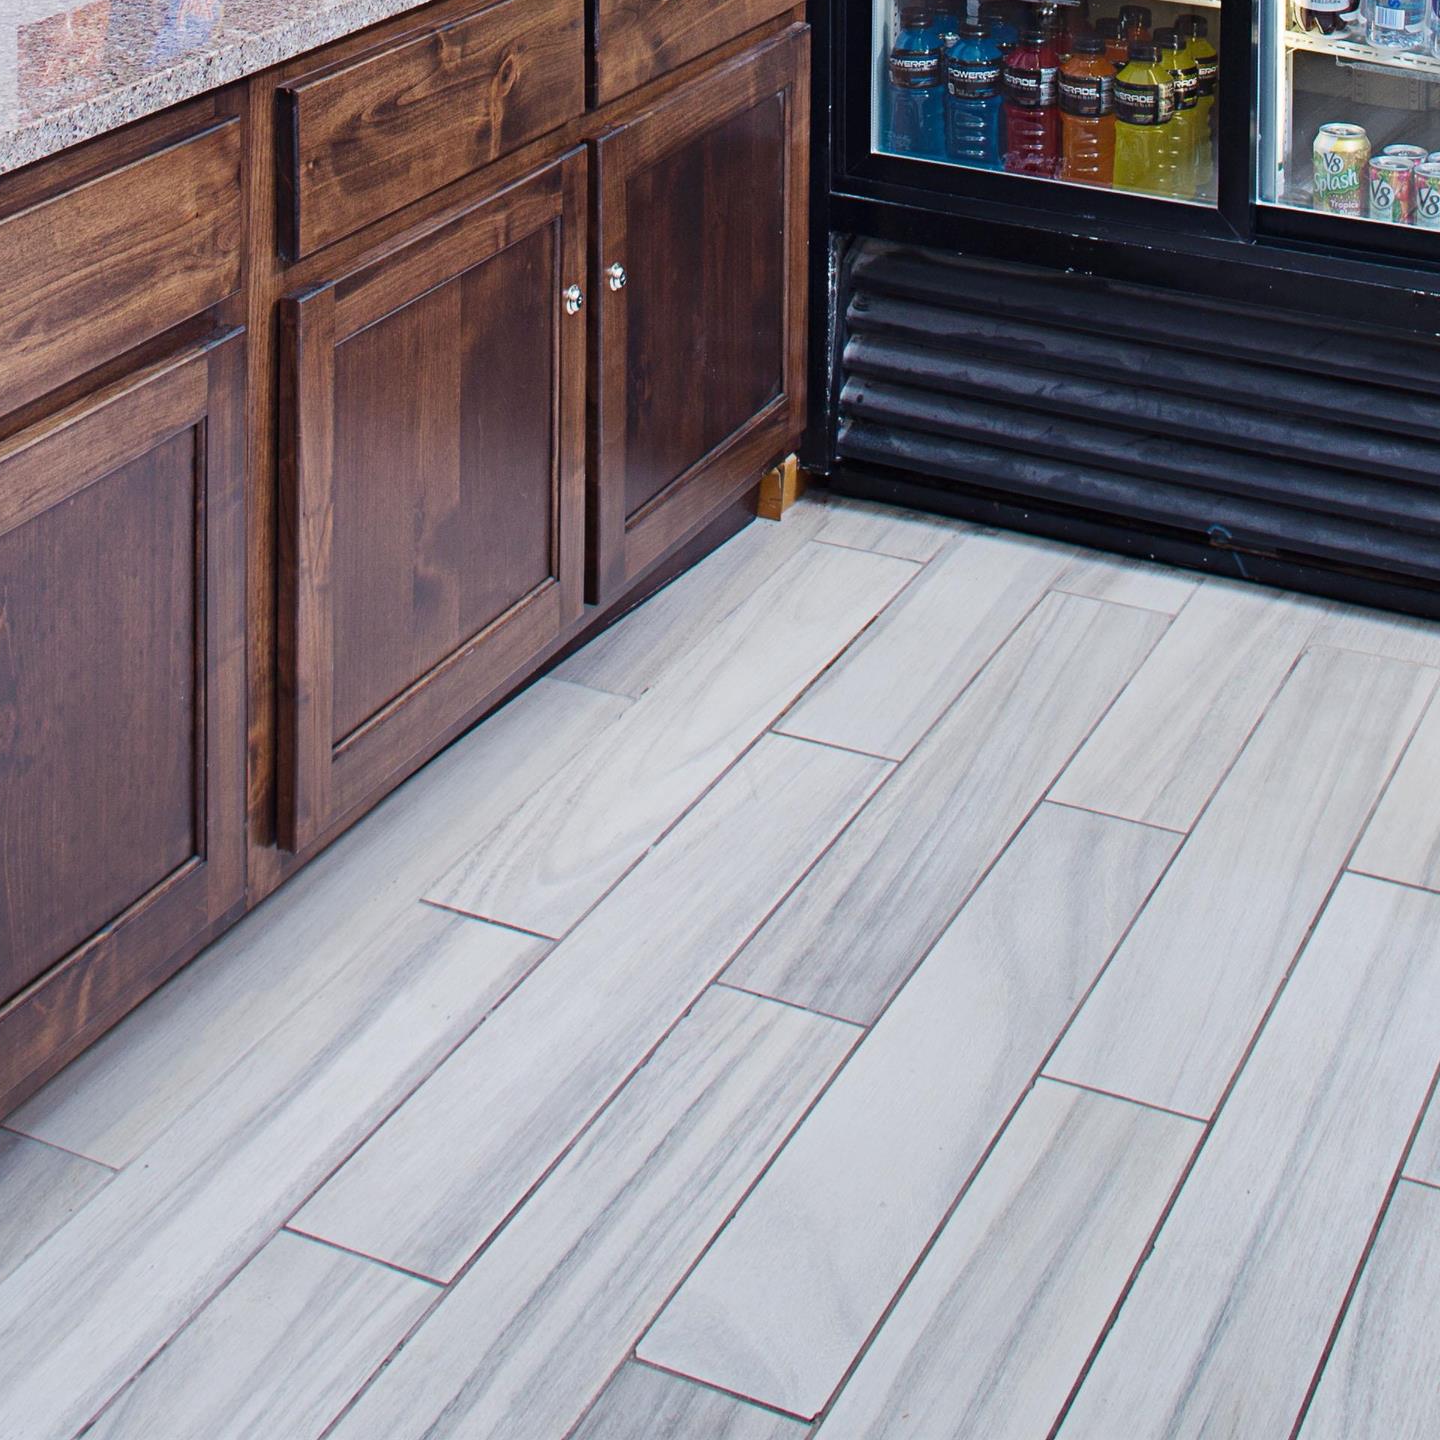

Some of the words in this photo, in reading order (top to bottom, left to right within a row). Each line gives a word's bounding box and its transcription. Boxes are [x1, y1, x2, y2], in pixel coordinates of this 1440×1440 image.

[1324, 152, 1340, 173] V8
[1314, 168, 1359, 193] Splash
[1371, 179, 1392, 207] V8
[1418, 186, 1440, 215] V8
